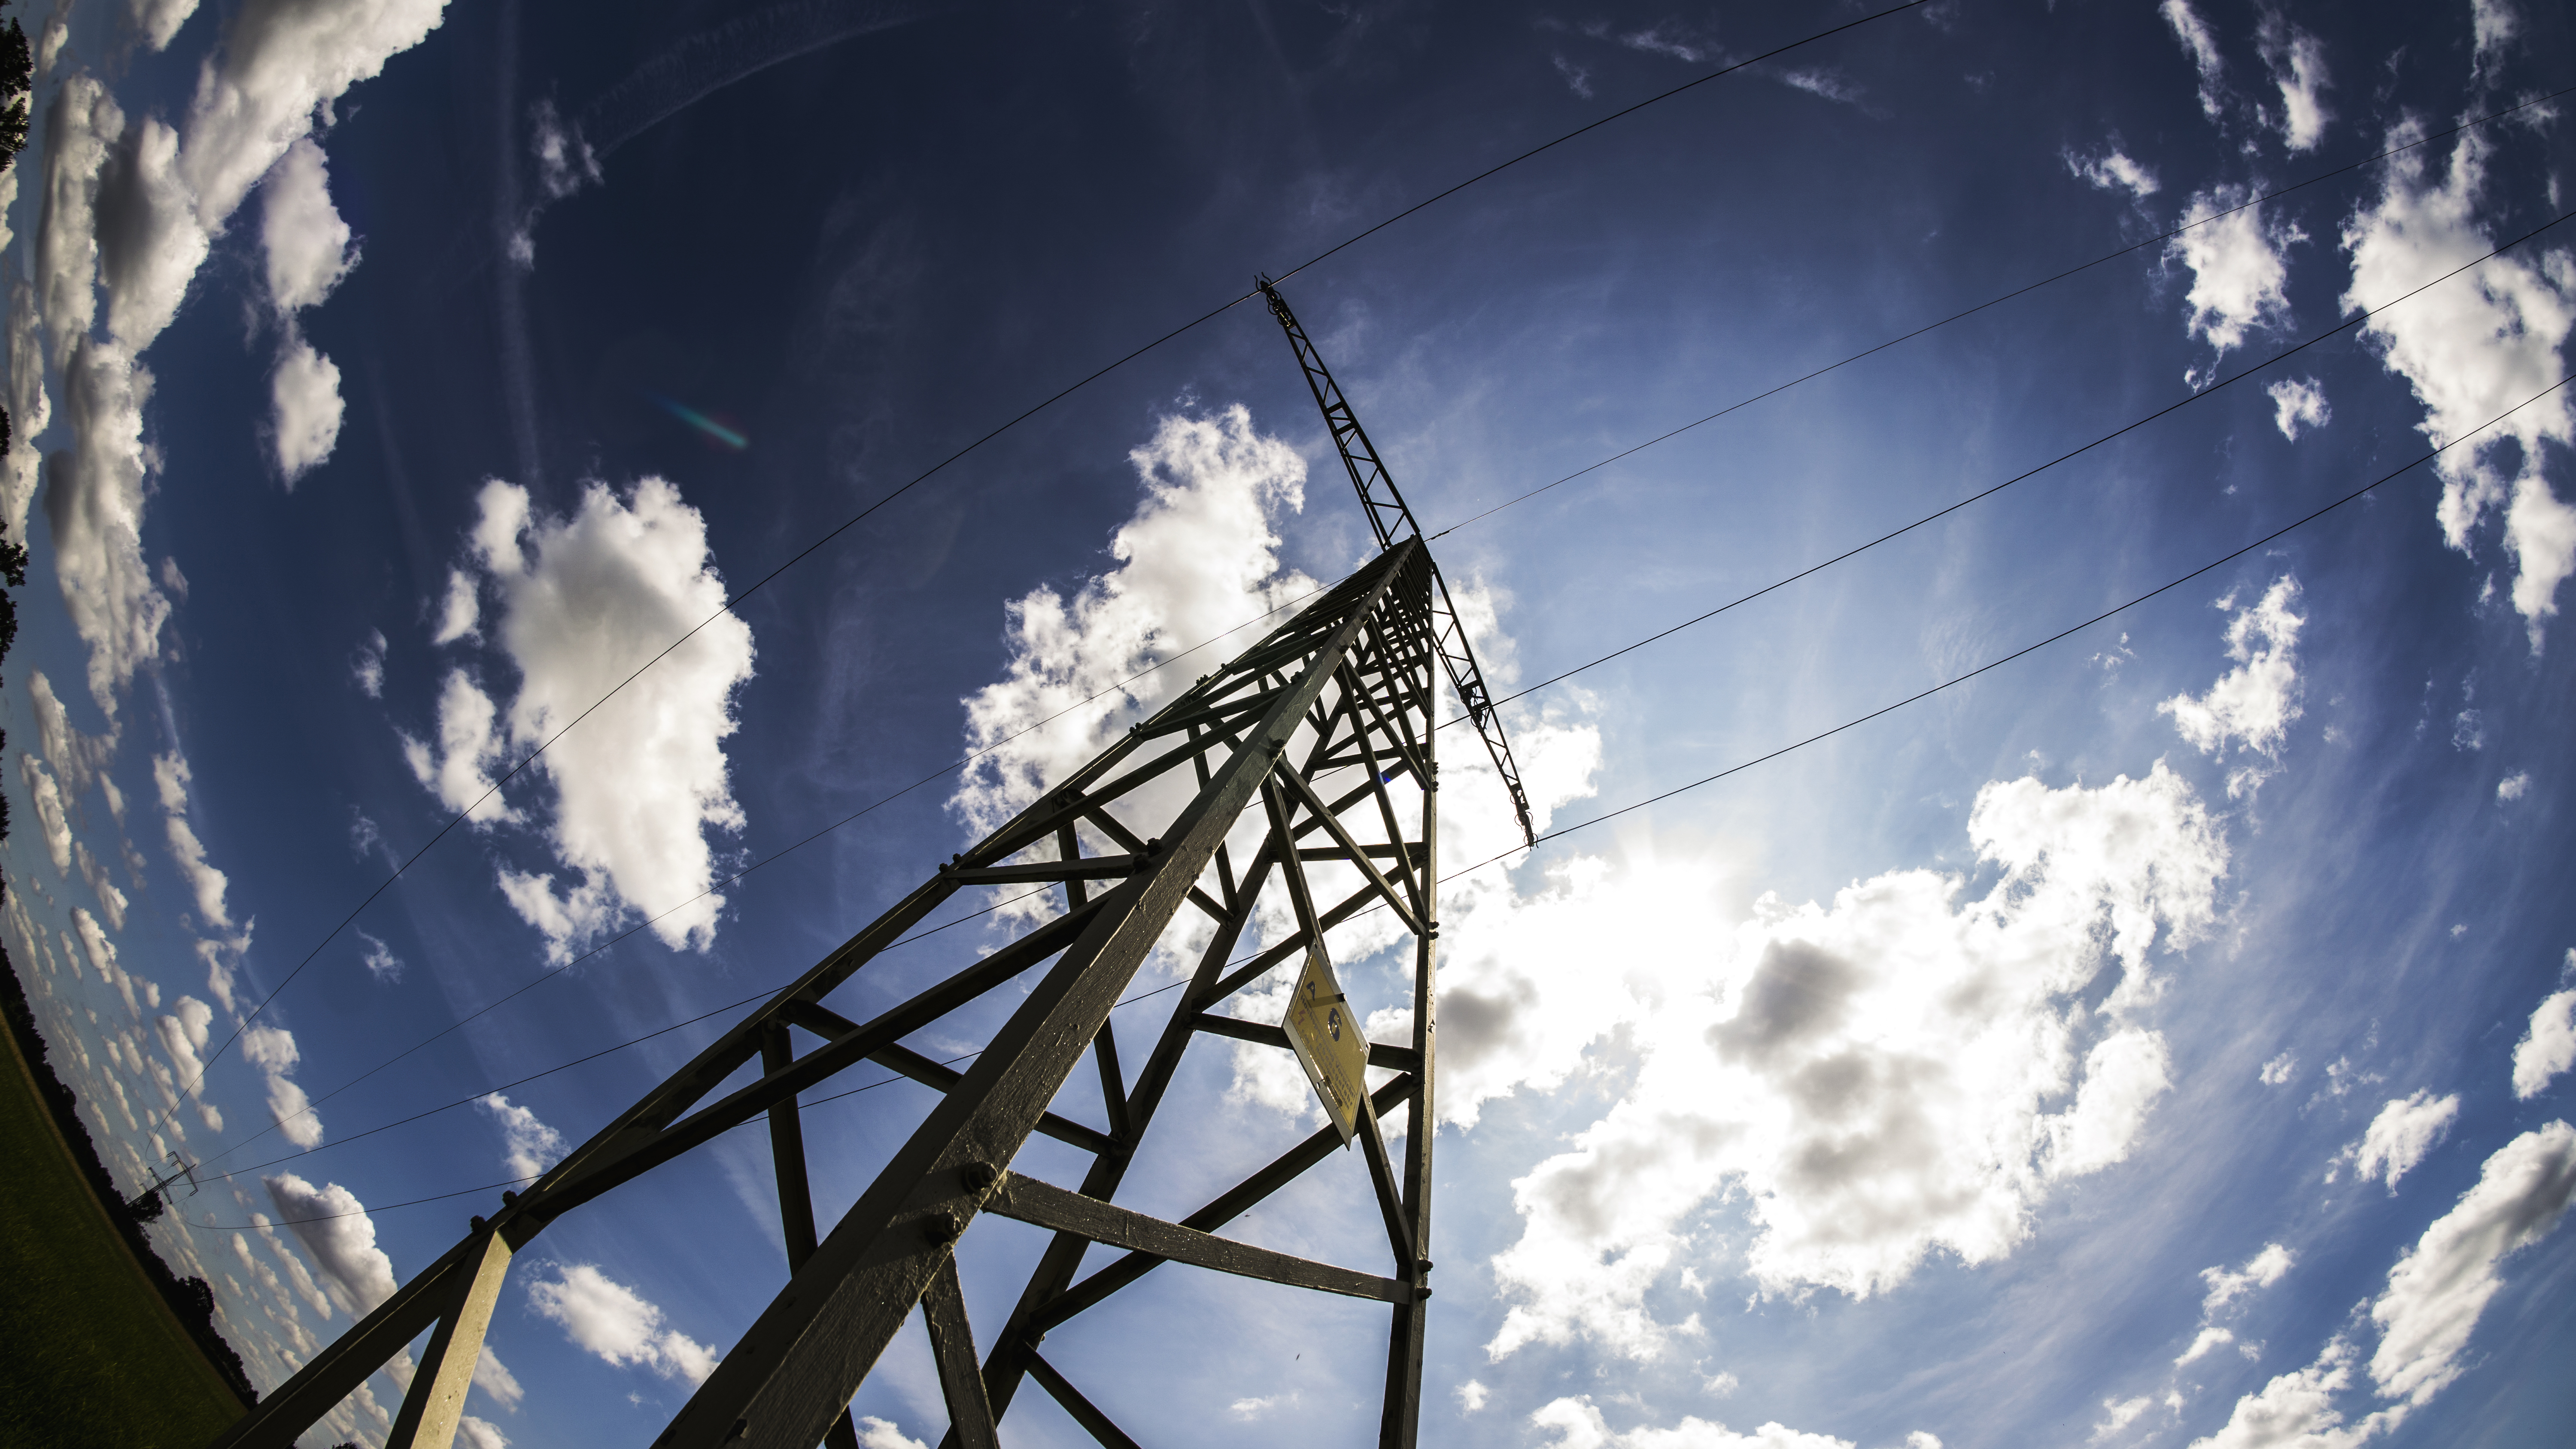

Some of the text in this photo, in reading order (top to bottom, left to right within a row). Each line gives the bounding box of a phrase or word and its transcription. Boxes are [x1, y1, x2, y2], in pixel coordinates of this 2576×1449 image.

[1306, 981, 1315, 1001] A
[1327, 1008, 1342, 1042] 6
[1335, 1060, 1355, 1101] Vorsicht!
